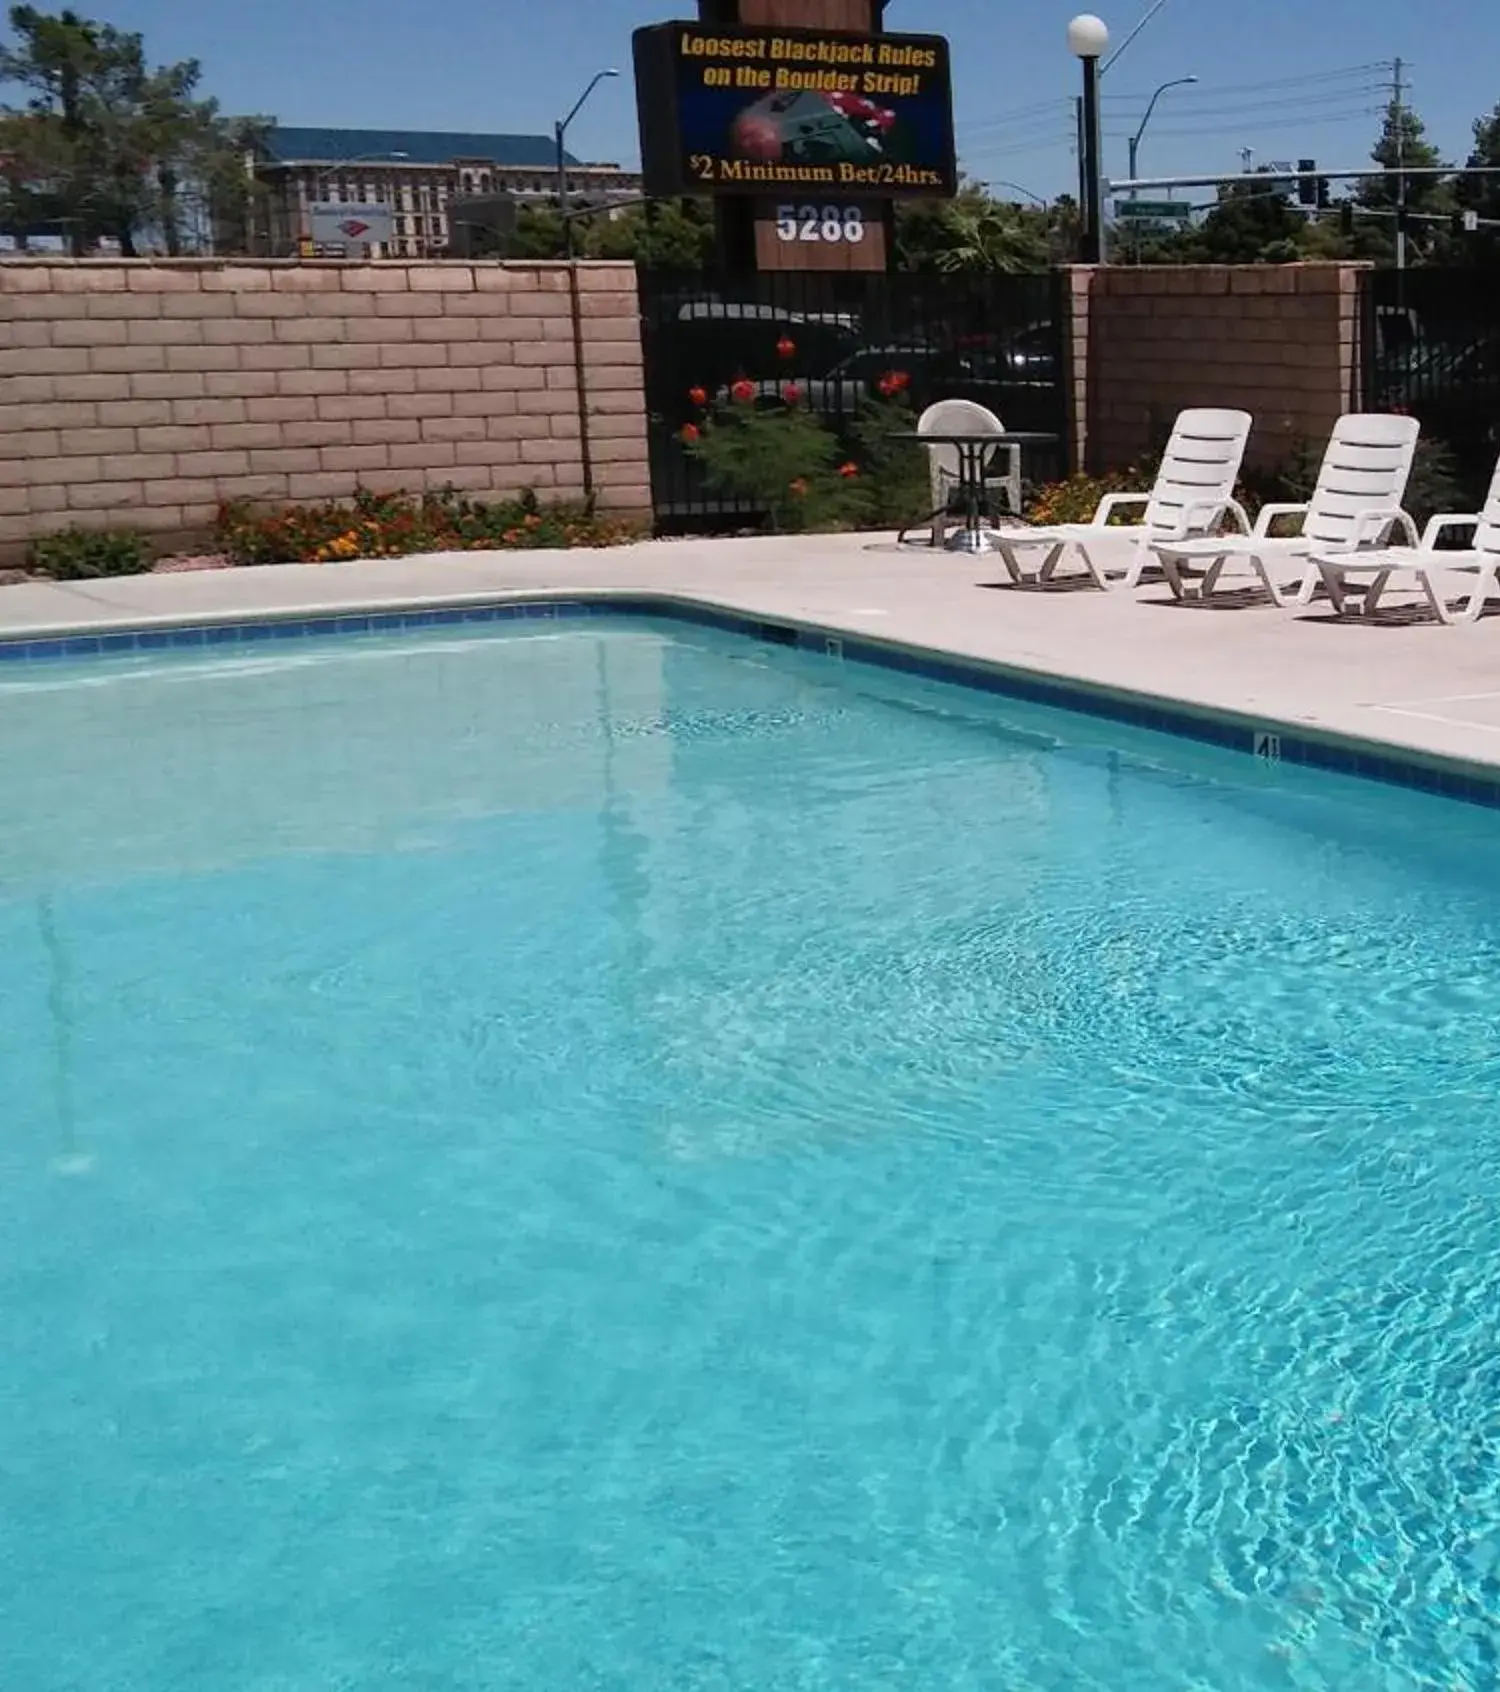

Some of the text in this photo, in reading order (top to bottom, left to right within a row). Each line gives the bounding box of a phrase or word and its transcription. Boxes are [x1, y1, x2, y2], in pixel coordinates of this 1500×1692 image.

[682, 33, 936, 67] Loosest Blackjack Rules
[704, 66, 920, 96] on the Boulder Strip!
[690, 154, 714, 179] $2
[720, 159, 833, 181] Minimum
[776, 205, 864, 242] 5288
